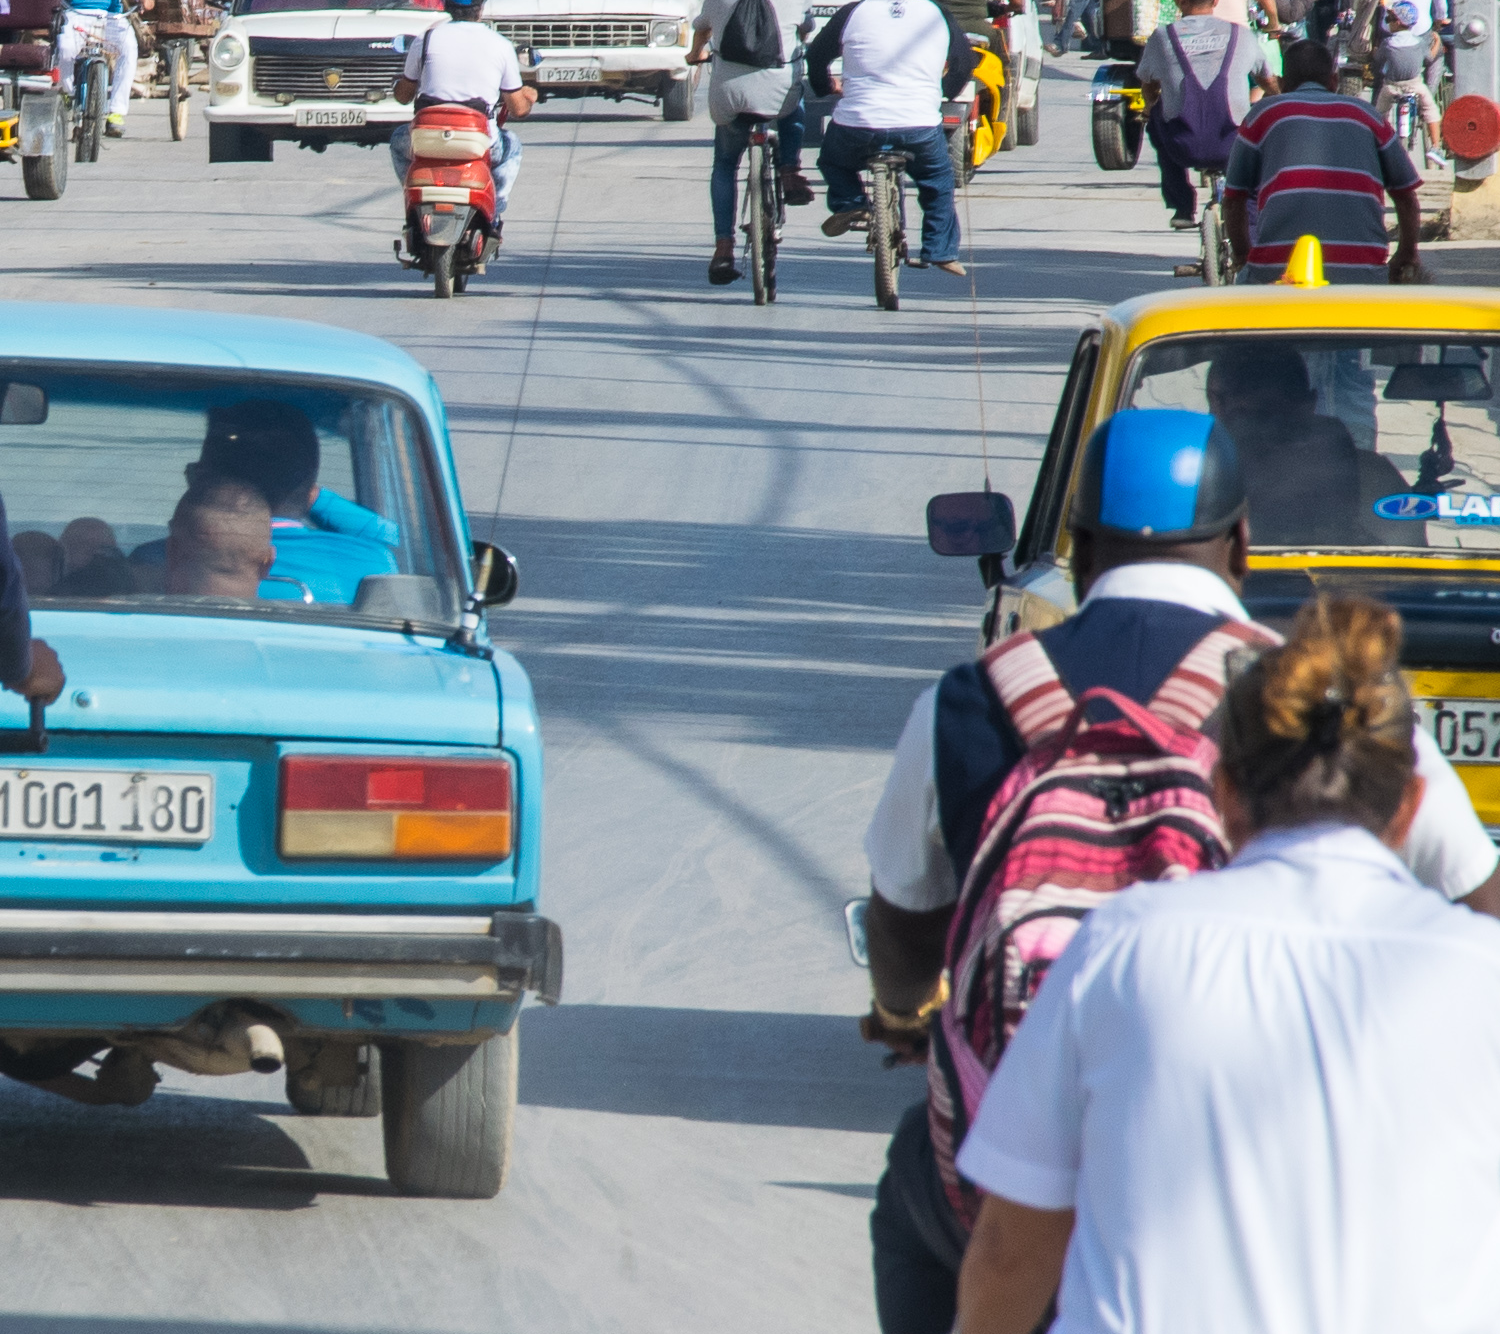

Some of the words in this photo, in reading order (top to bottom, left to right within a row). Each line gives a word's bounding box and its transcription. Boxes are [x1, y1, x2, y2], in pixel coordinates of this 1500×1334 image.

[546, 69, 554, 82] P
[556, 69, 576, 81] 127
[305, 110, 313, 125] P
[315, 111, 338, 125] 015
[340, 110, 364, 125] 896
[22, 780, 107, 832] 001
[118, 782, 206, 835] 180
